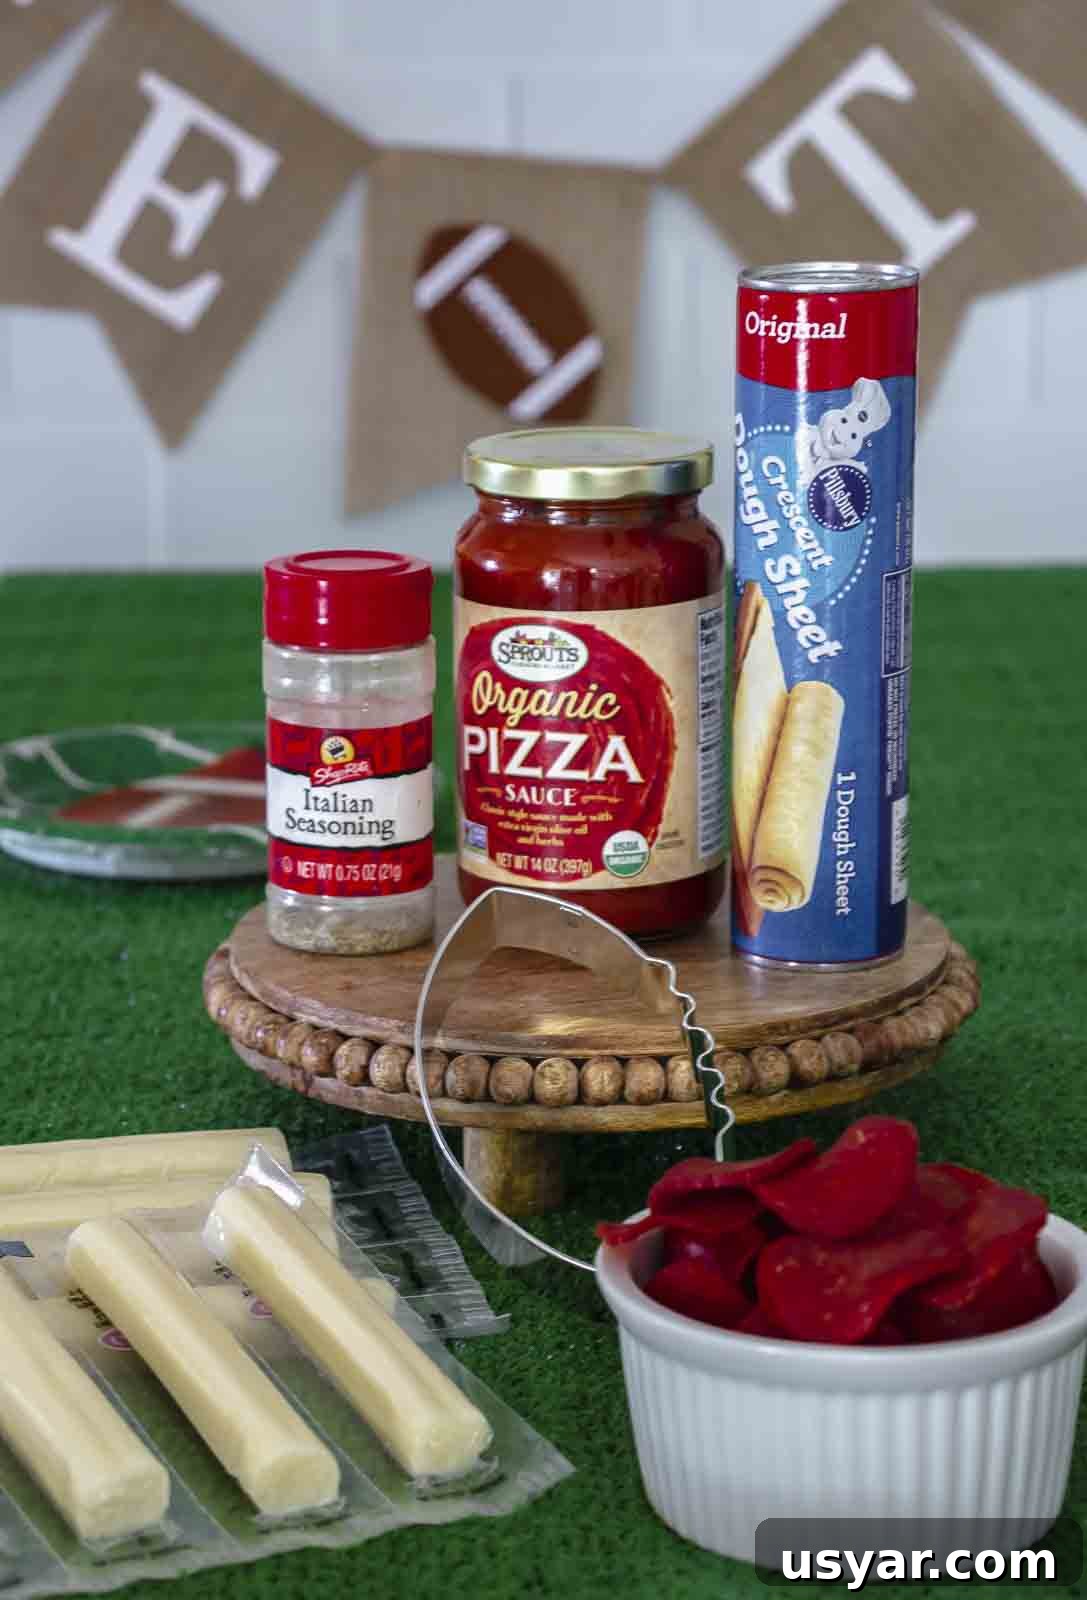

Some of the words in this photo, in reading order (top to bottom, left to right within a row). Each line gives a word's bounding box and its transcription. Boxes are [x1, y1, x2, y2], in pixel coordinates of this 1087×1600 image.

[745, 45, 977, 278] T
[47, 71, 282, 332] E
[745, 312, 848, 345] Original
[761, 455, 835, 571] Crescent
[819, 467, 861, 527] Pillsbury
[764, 554, 844, 664] Sheet
[498, 641, 579, 664] SPROUTS
[472, 670, 621, 728] Organic
[463, 725, 646, 783] PIZZA
[837, 771, 857, 785] 1
[303, 788, 374, 813] Italian
[504, 783, 578, 807] SAUCE
[285, 808, 396, 840] Seasoning
[831, 790, 857, 857] Dough
[297, 861, 316, 879] NET
[317, 863, 334, 880] WT
[495, 851, 514, 869] NET
[835, 860, 857, 916] Sheet
